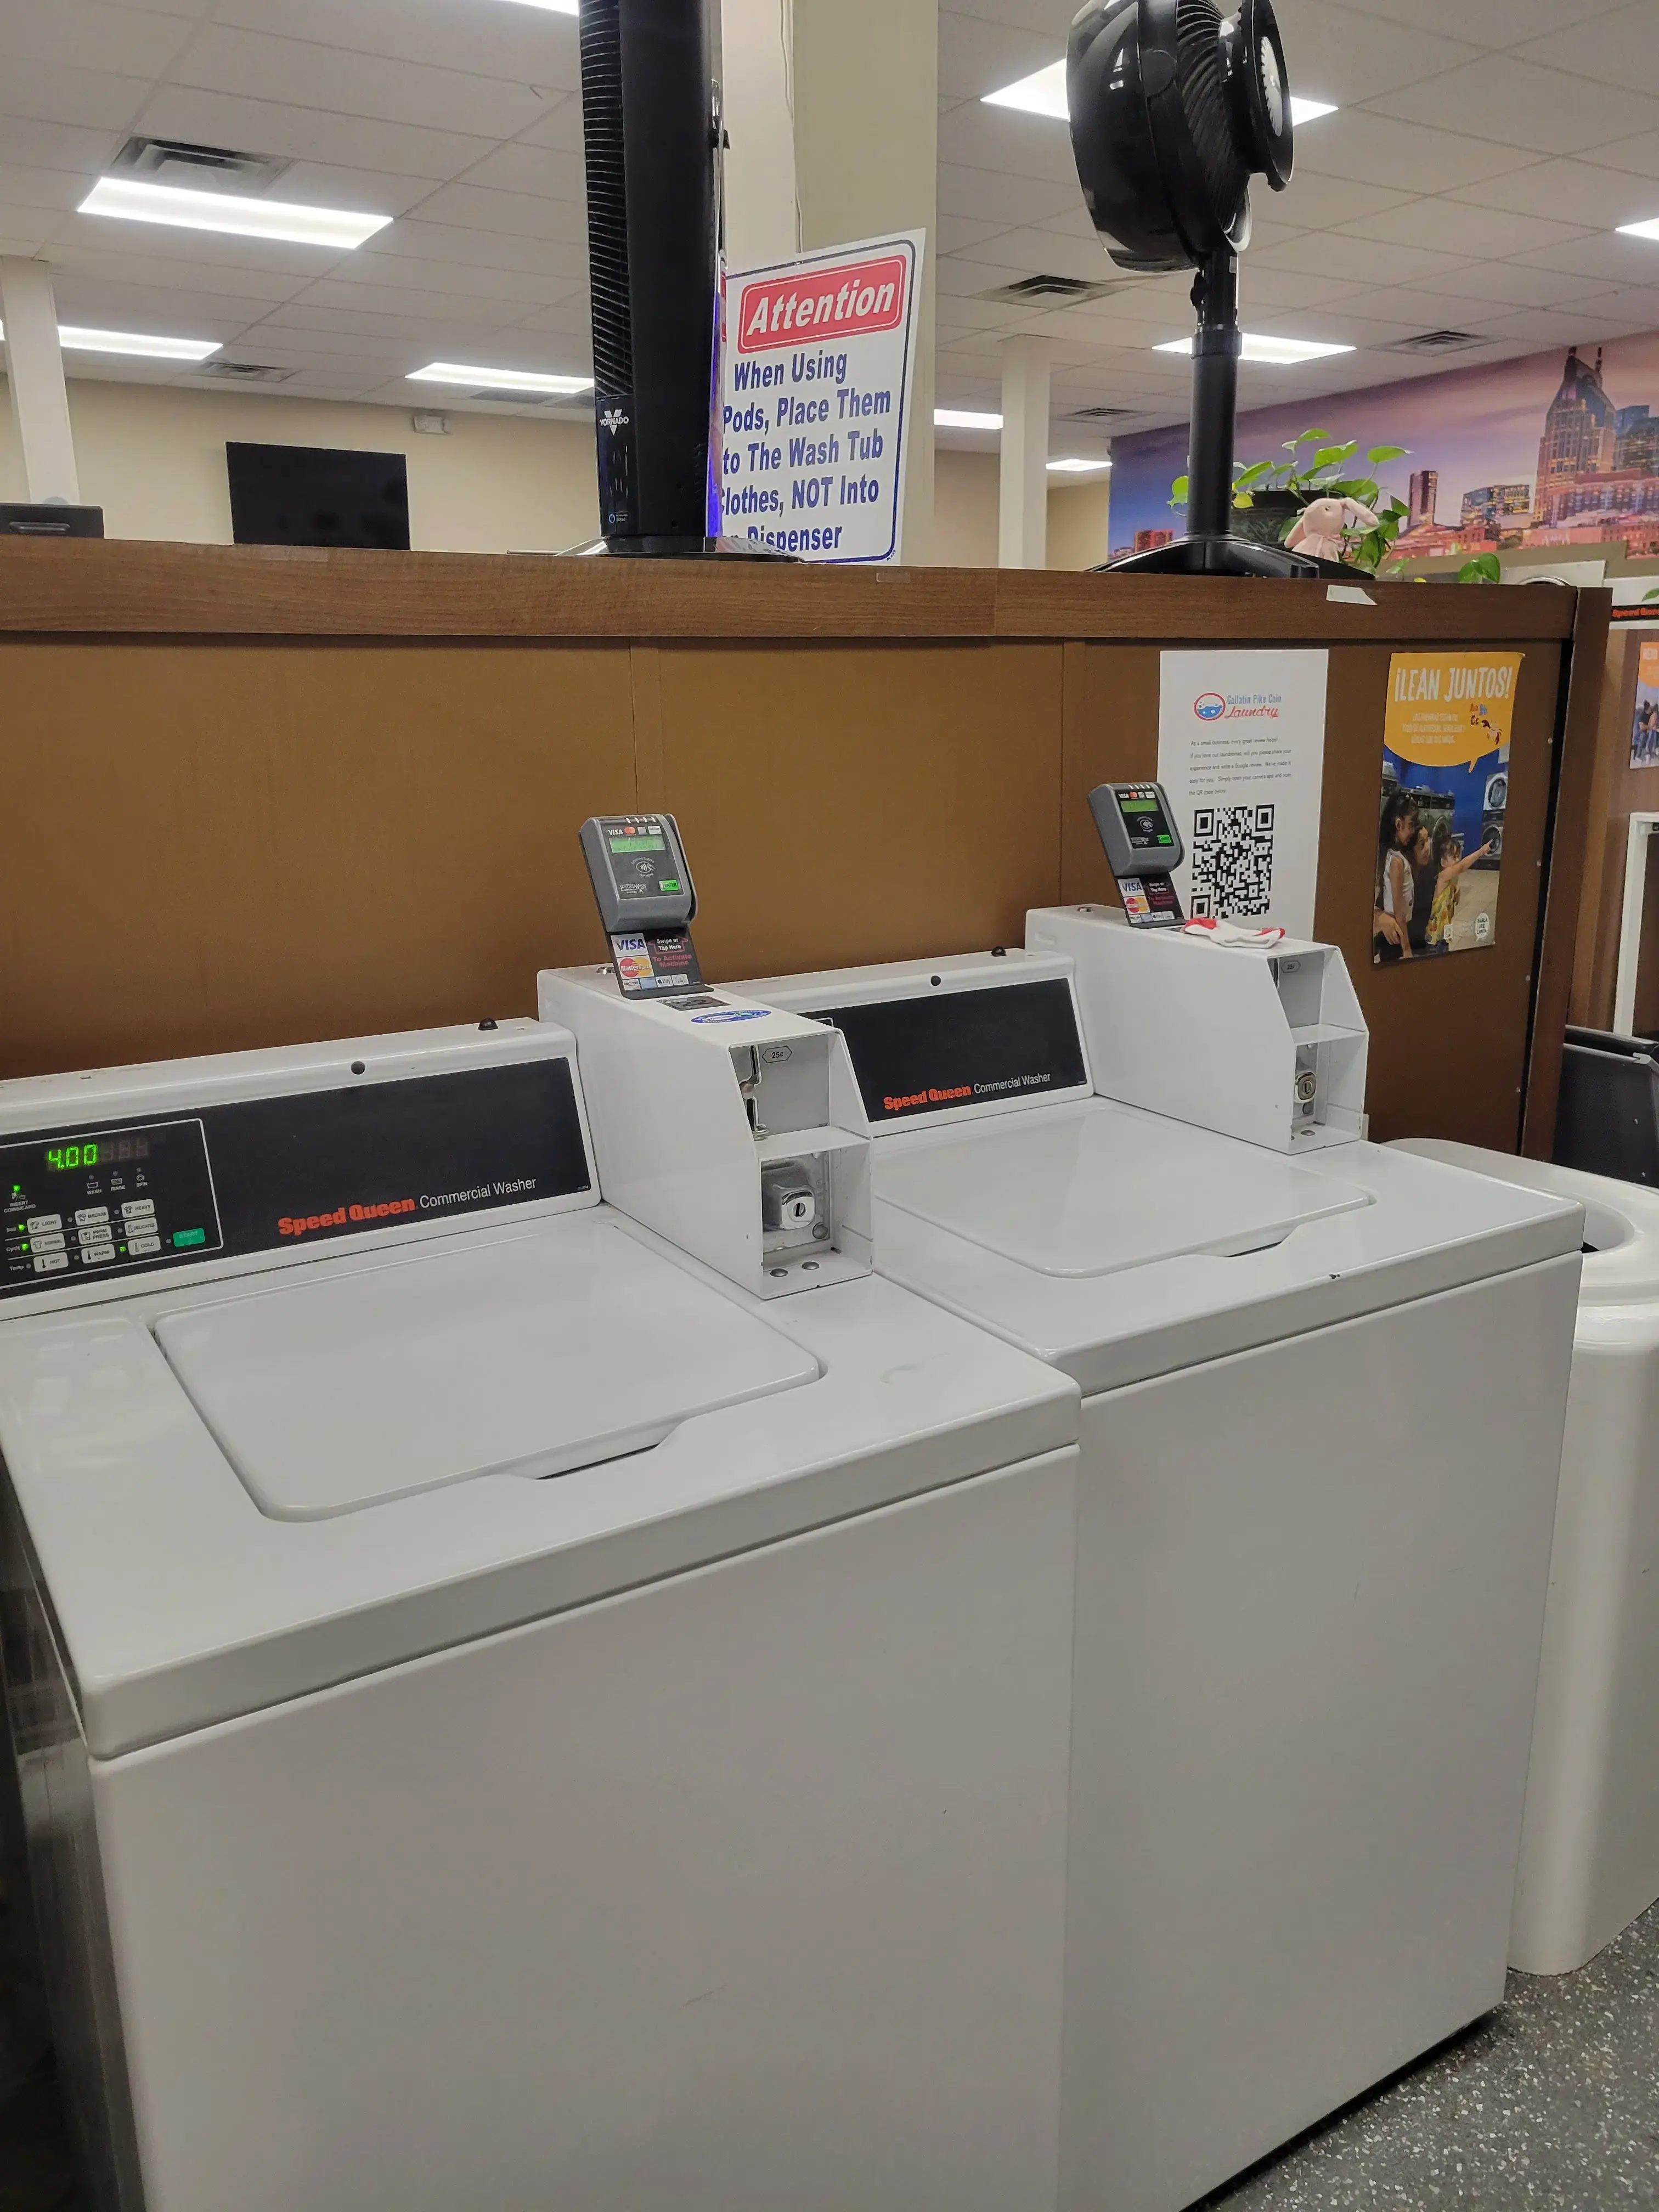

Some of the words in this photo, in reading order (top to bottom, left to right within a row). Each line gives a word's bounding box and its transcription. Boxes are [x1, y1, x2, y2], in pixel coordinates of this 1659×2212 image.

[747, 280, 895, 336] Attention
[735, 362, 784, 391] When
[792, 350, 847, 385] Using
[600, 416, 629, 427] VORNADO
[724, 402, 769, 435] Pods,
[777, 396, 828, 427] Place
[837, 388, 890, 419] Them
[748, 442, 781, 471] The
[789, 433, 839, 467] Wash
[848, 428, 883, 460] Tub
[792, 476, 833, 509] NOT
[840, 475, 878, 505] Into
[1227, 695, 1251, 704] Gallatin
[1253, 695, 1266, 703] Pike
[1268, 694, 1282, 703] Coin
[1395, 668, 1441, 702] ¡LEAN
[1444, 666, 1513, 702] JUNTOS!
[1224, 706, 1279, 719] Laundry
[1122, 882, 1142, 892] VISA
[616, 939, 646, 951] VISA
[884, 1091, 928, 1111] Speed
[928, 1085, 972, 1101] Queen
[974, 1076, 1021, 1094] Commercial
[1022, 1073, 1051, 1086] Washer
[48, 1144, 97, 1169] 4.00
[278, 1206, 347, 1236] Speed
[349, 1197, 415, 1221] Queen
[420, 1186, 490, 1209] Commercial
[493, 1178, 537, 1195] Washer
